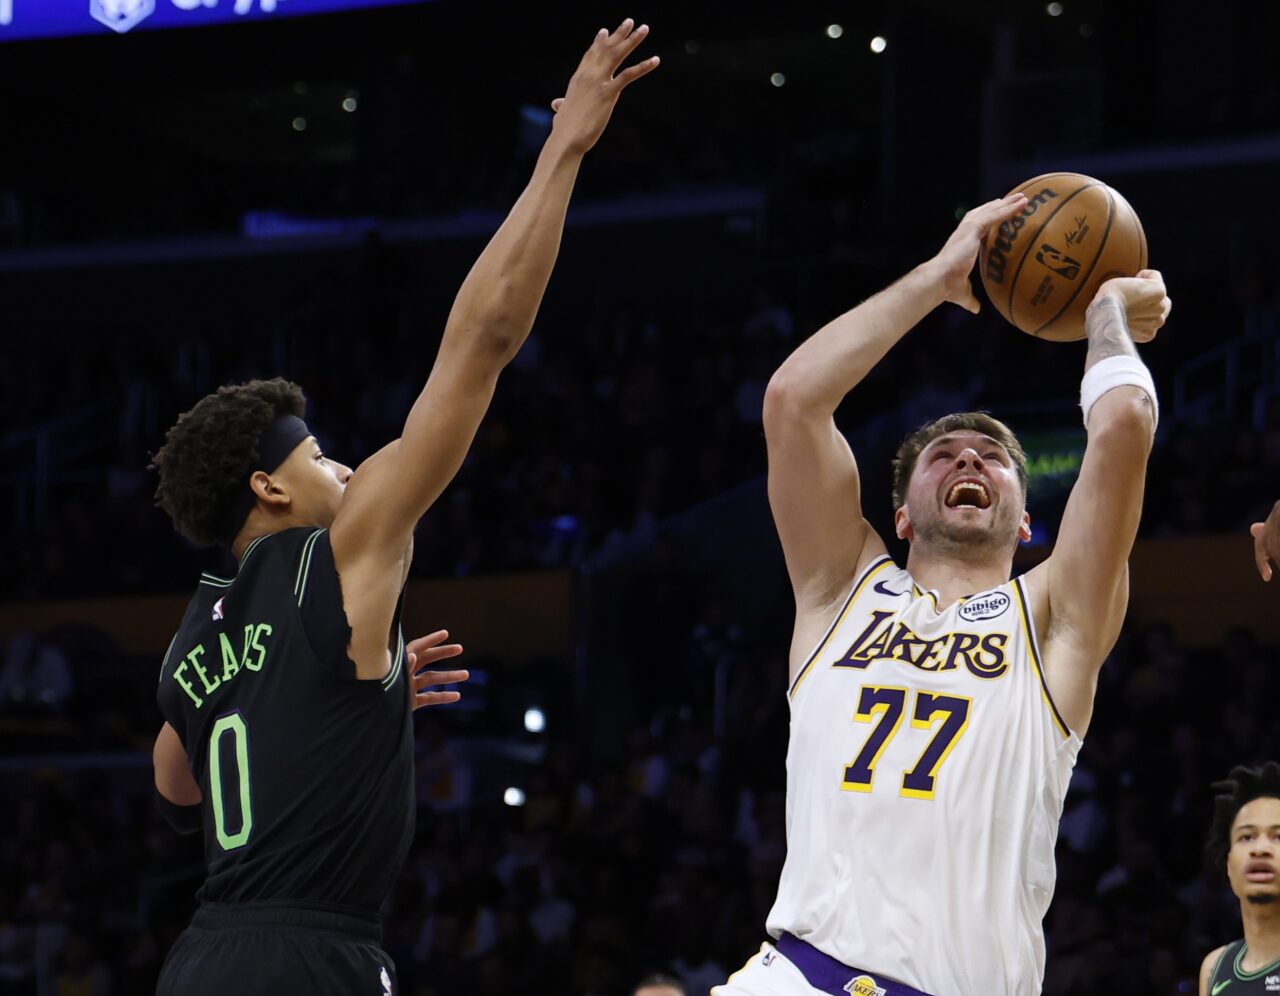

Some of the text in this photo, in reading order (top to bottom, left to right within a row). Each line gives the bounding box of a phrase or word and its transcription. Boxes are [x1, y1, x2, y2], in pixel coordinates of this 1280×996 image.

[831, 610, 1011, 681] LAKERS
[963, 598, 1007, 614] bibigo
[209, 712, 252, 851] 0
[839, 684, 974, 801] 77
